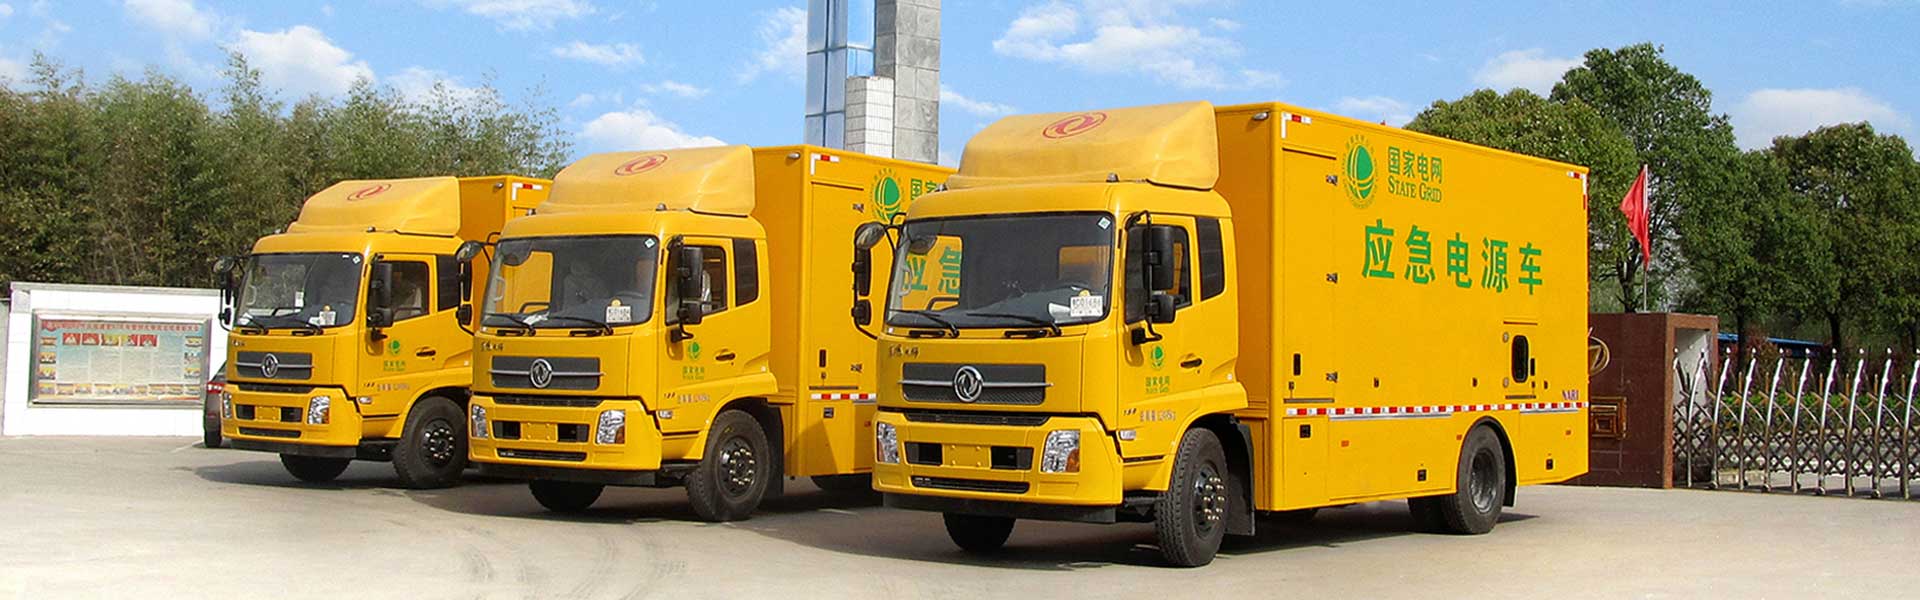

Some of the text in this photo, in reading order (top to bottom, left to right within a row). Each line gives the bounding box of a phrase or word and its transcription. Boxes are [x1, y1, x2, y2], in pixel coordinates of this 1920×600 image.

[1388, 146, 1442, 184] 国家电网
[1388, 175, 1443, 203] STATE GRID
[1362, 219, 1543, 295] 应急电源车
